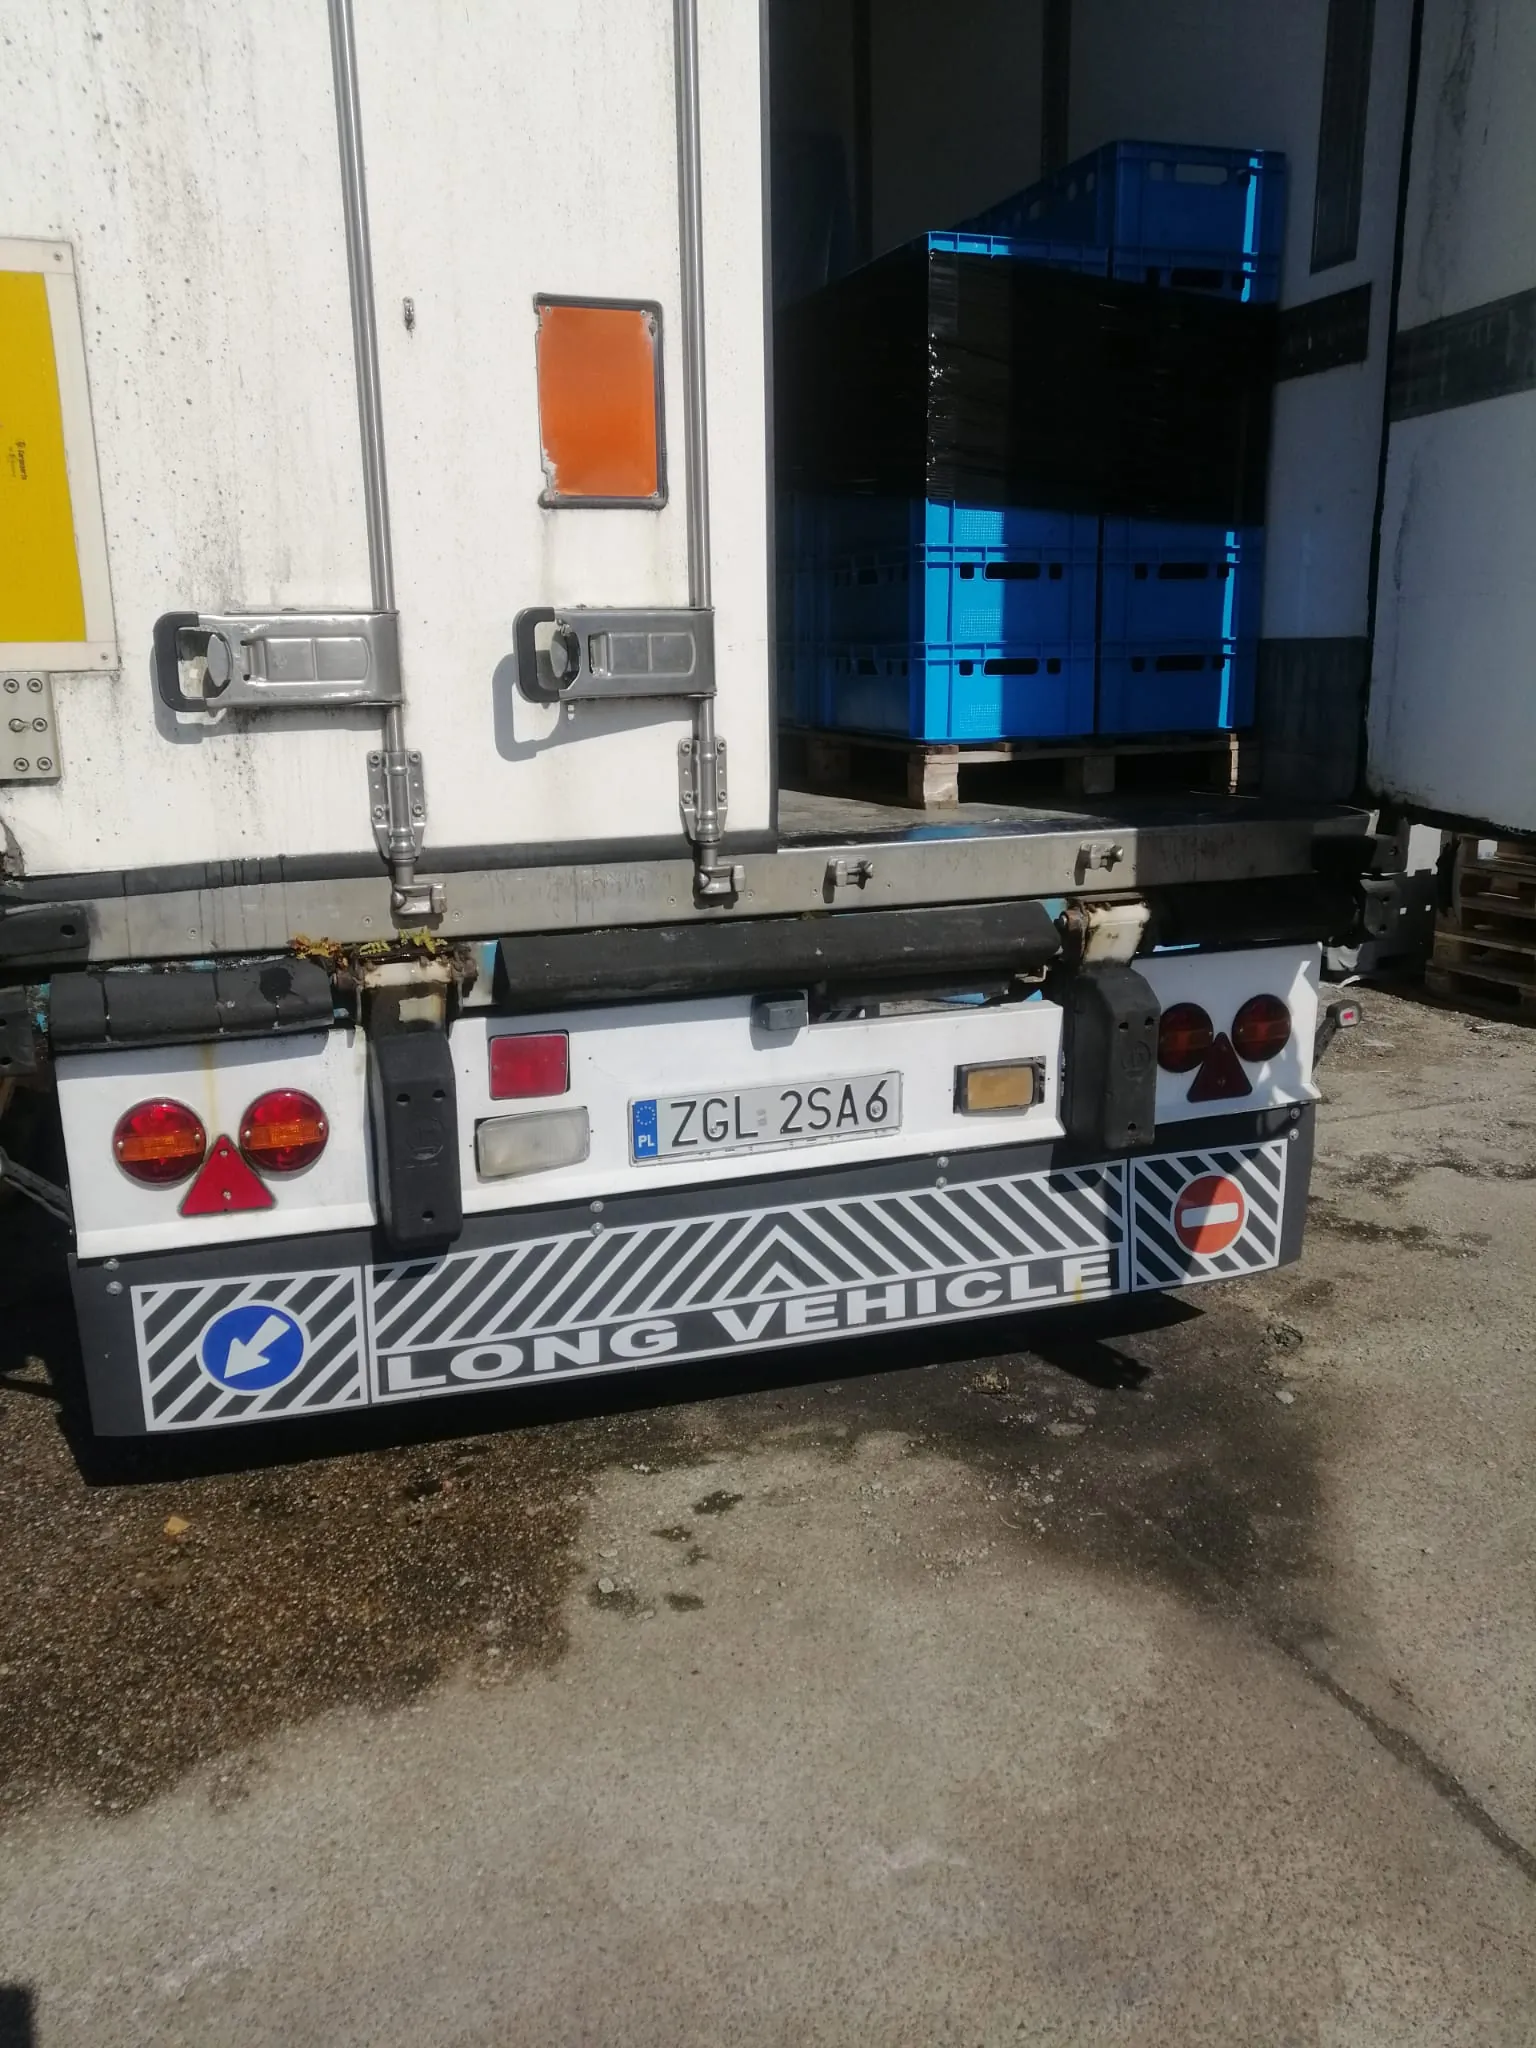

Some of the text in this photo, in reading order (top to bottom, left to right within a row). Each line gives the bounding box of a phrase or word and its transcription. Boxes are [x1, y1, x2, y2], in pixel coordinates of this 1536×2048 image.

[637, 1134, 656, 1148] PL
[670, 1079, 889, 1148] ZGL 2SA6
[386, 1252, 1112, 1392] LONG VEHICLE
